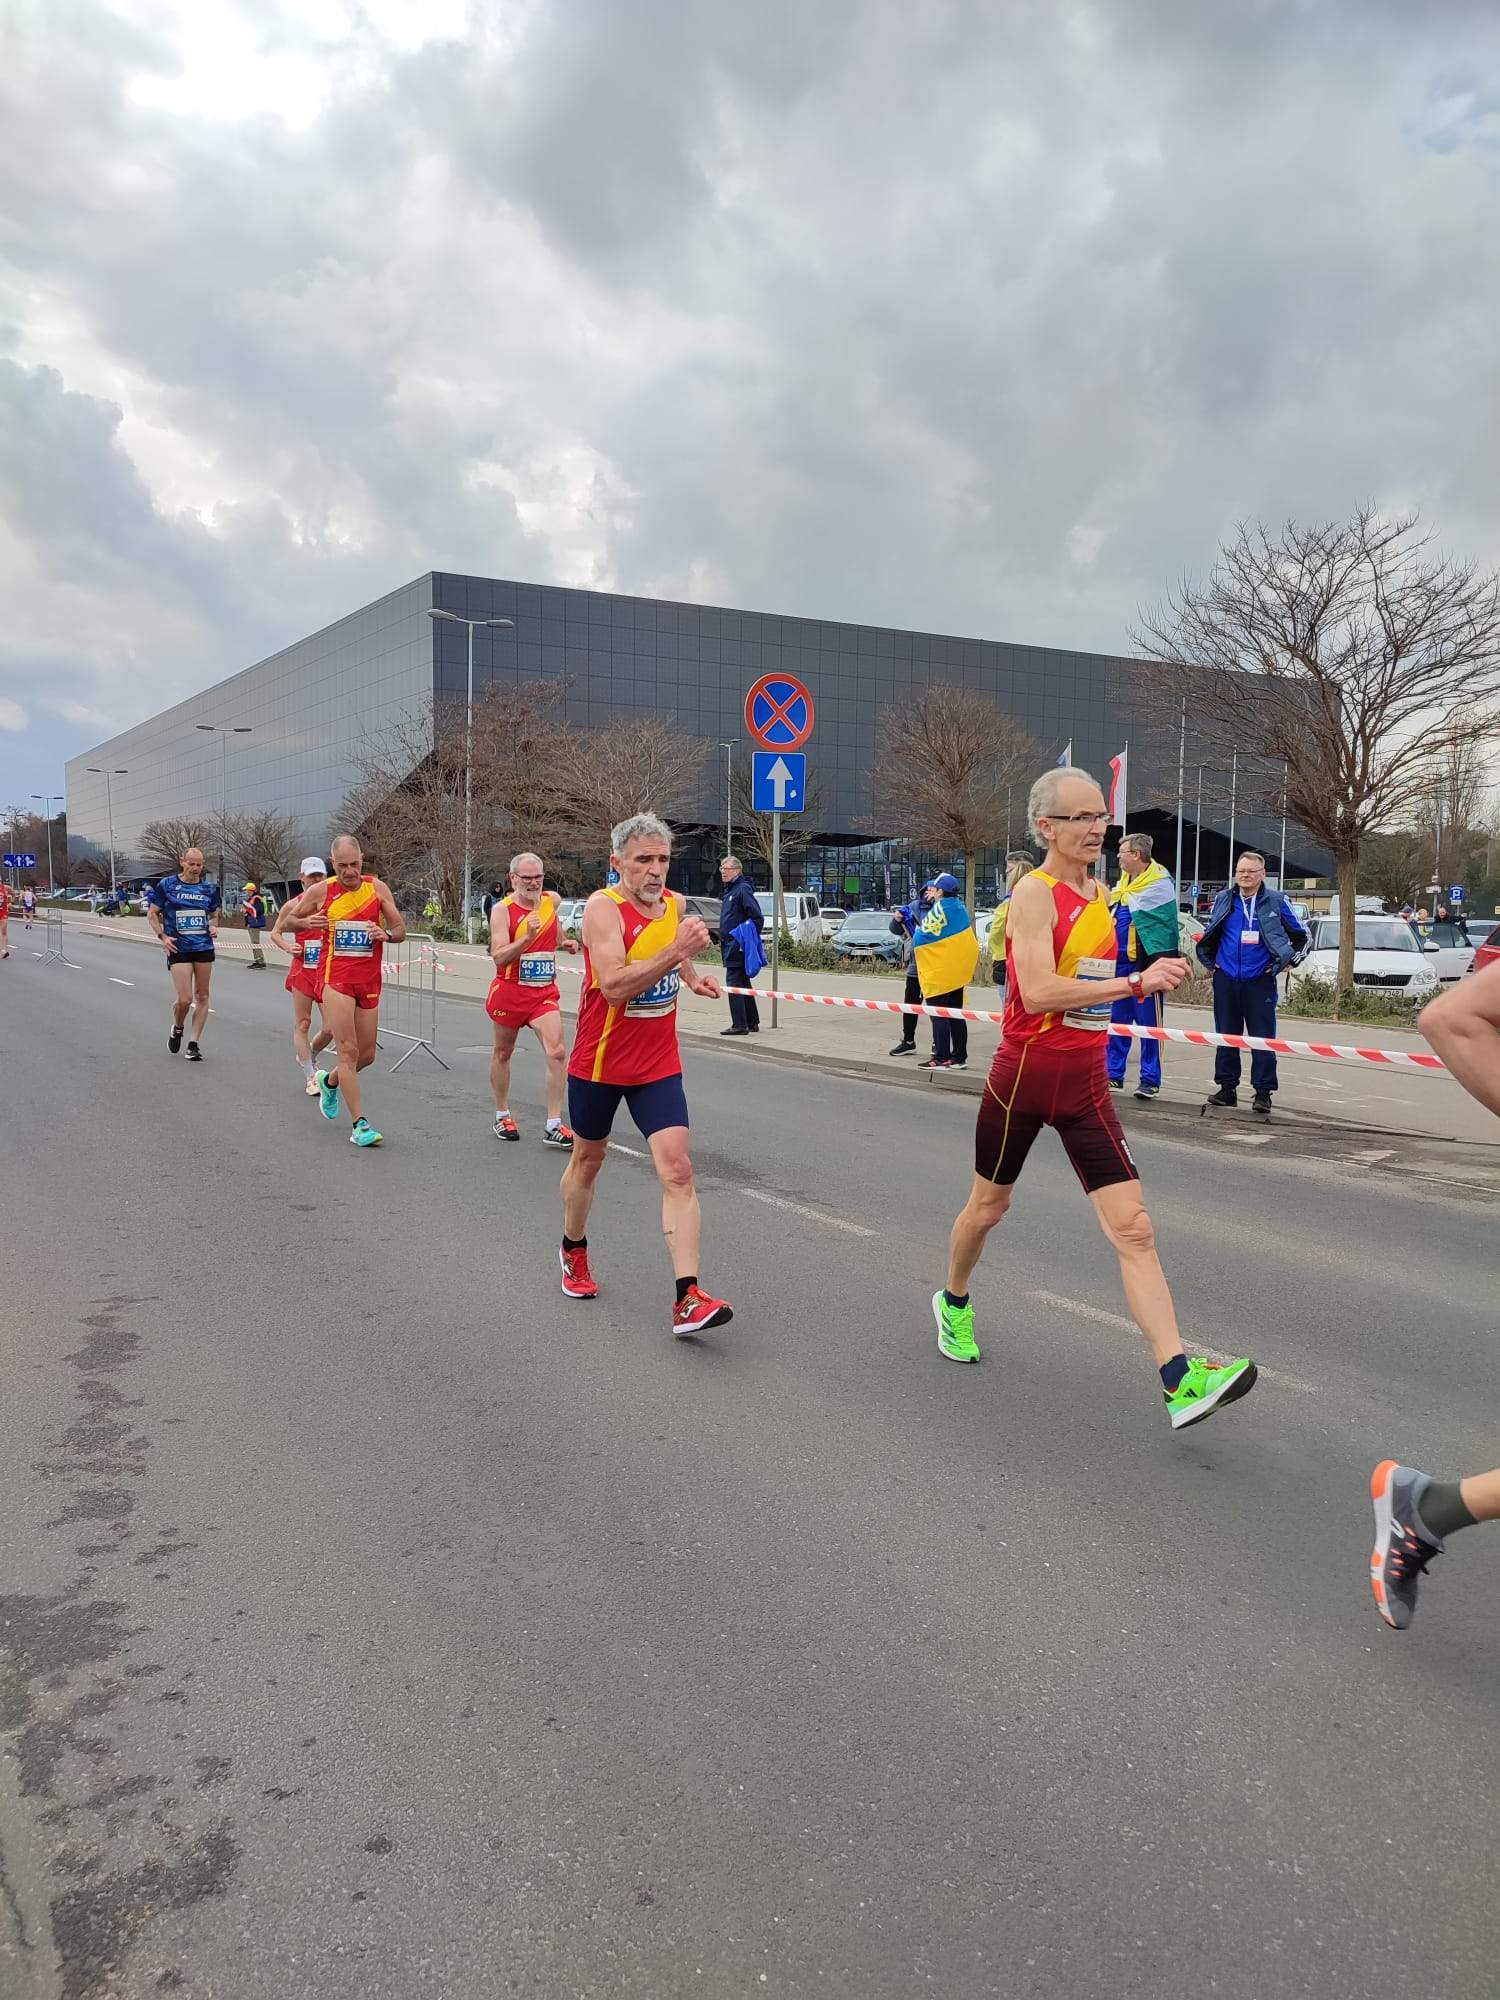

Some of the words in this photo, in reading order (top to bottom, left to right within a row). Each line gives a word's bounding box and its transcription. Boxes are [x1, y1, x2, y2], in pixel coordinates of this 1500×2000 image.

[608, 873, 615, 882] P
[1453, 890, 1460, 898] P
[190, 917, 203, 925] 652
[336, 930, 348, 938] 55
[522, 960, 534, 968] 60
[536, 961, 554, 975] 3383
